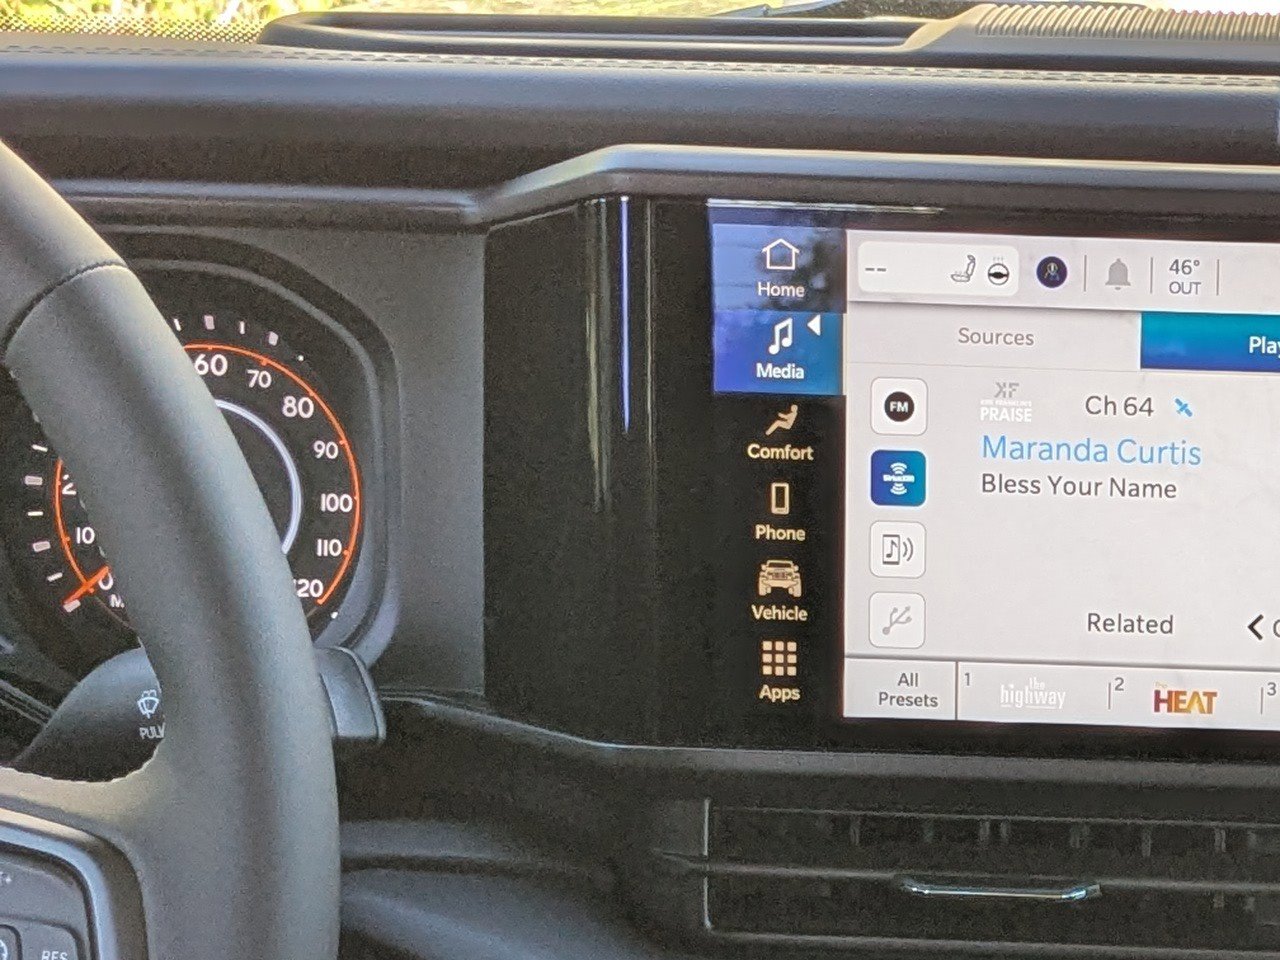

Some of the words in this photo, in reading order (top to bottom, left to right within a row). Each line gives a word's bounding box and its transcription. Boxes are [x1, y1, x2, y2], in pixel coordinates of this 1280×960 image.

[1169, 259, 1200, 275] 46°
[758, 282, 805, 298] Home
[1169, 281, 1201, 295] OUT
[958, 327, 1035, 346] Sources
[195, 354, 227, 376] 60
[756, 364, 804, 380] Media
[246, 370, 272, 389] 70
[282, 397, 314, 418] 80
[889, 401, 909, 413] FM
[980, 406, 1032, 422] PRAISE
[1085, 395, 1117, 416] Ch
[1123, 396, 1154, 417] 64
[314, 442, 339, 460] 90
[747, 443, 814, 462] Comfort
[983, 435, 1108, 464] Maranda
[1117, 438, 1201, 466] Curtis
[981, 474, 1040, 495] Bless
[1047, 476, 1103, 497] Your
[1109, 478, 1177, 499] Name
[320, 494, 353, 512] 100
[76, 526, 95, 544] 10
[755, 524, 806, 541] Phone
[316, 540, 342, 557] 110
[293, 578, 323, 597] 20
[751, 605, 808, 622] Vehicle
[1087, 613, 1174, 635] Related
[897, 672, 919, 687] All
[964, 673, 971, 686] 1
[1114, 677, 1125, 691] 2
[759, 685, 801, 702] Apps
[1000, 685, 1066, 709] highway
[1267, 682, 1277, 696] 3
[878, 692, 938, 709] Presets
[1154, 689, 1218, 714] HEAT
